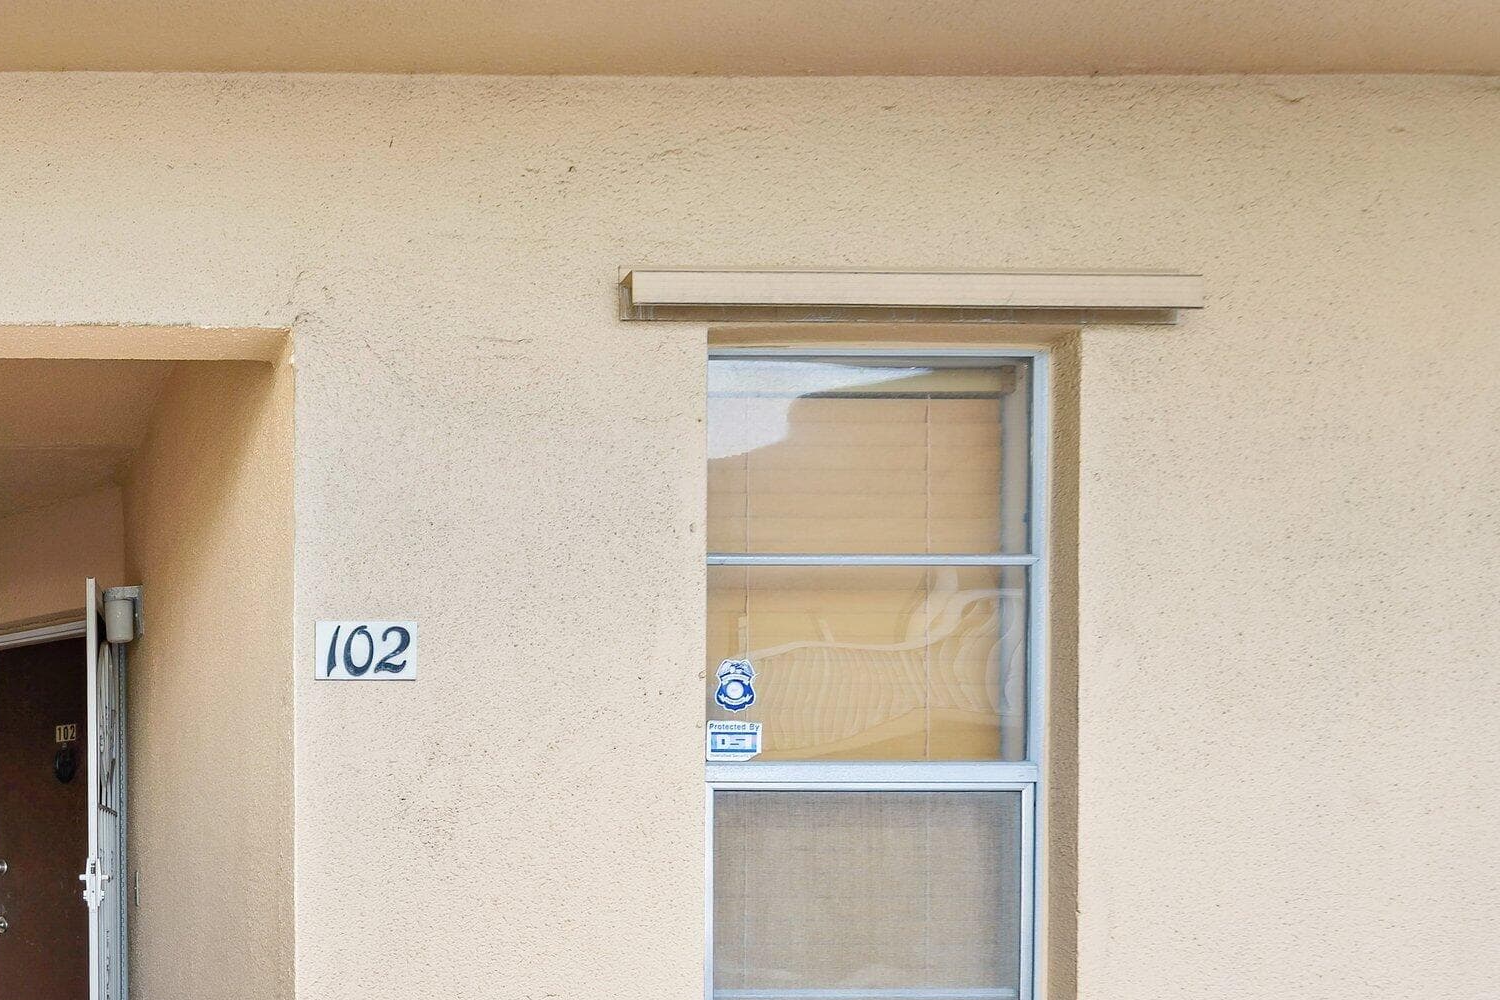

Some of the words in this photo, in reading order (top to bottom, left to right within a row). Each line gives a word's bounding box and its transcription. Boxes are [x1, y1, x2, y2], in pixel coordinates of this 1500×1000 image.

[327, 625, 410, 677] 102
[57, 725, 75, 741] 102
[749, 723, 760, 731] By
